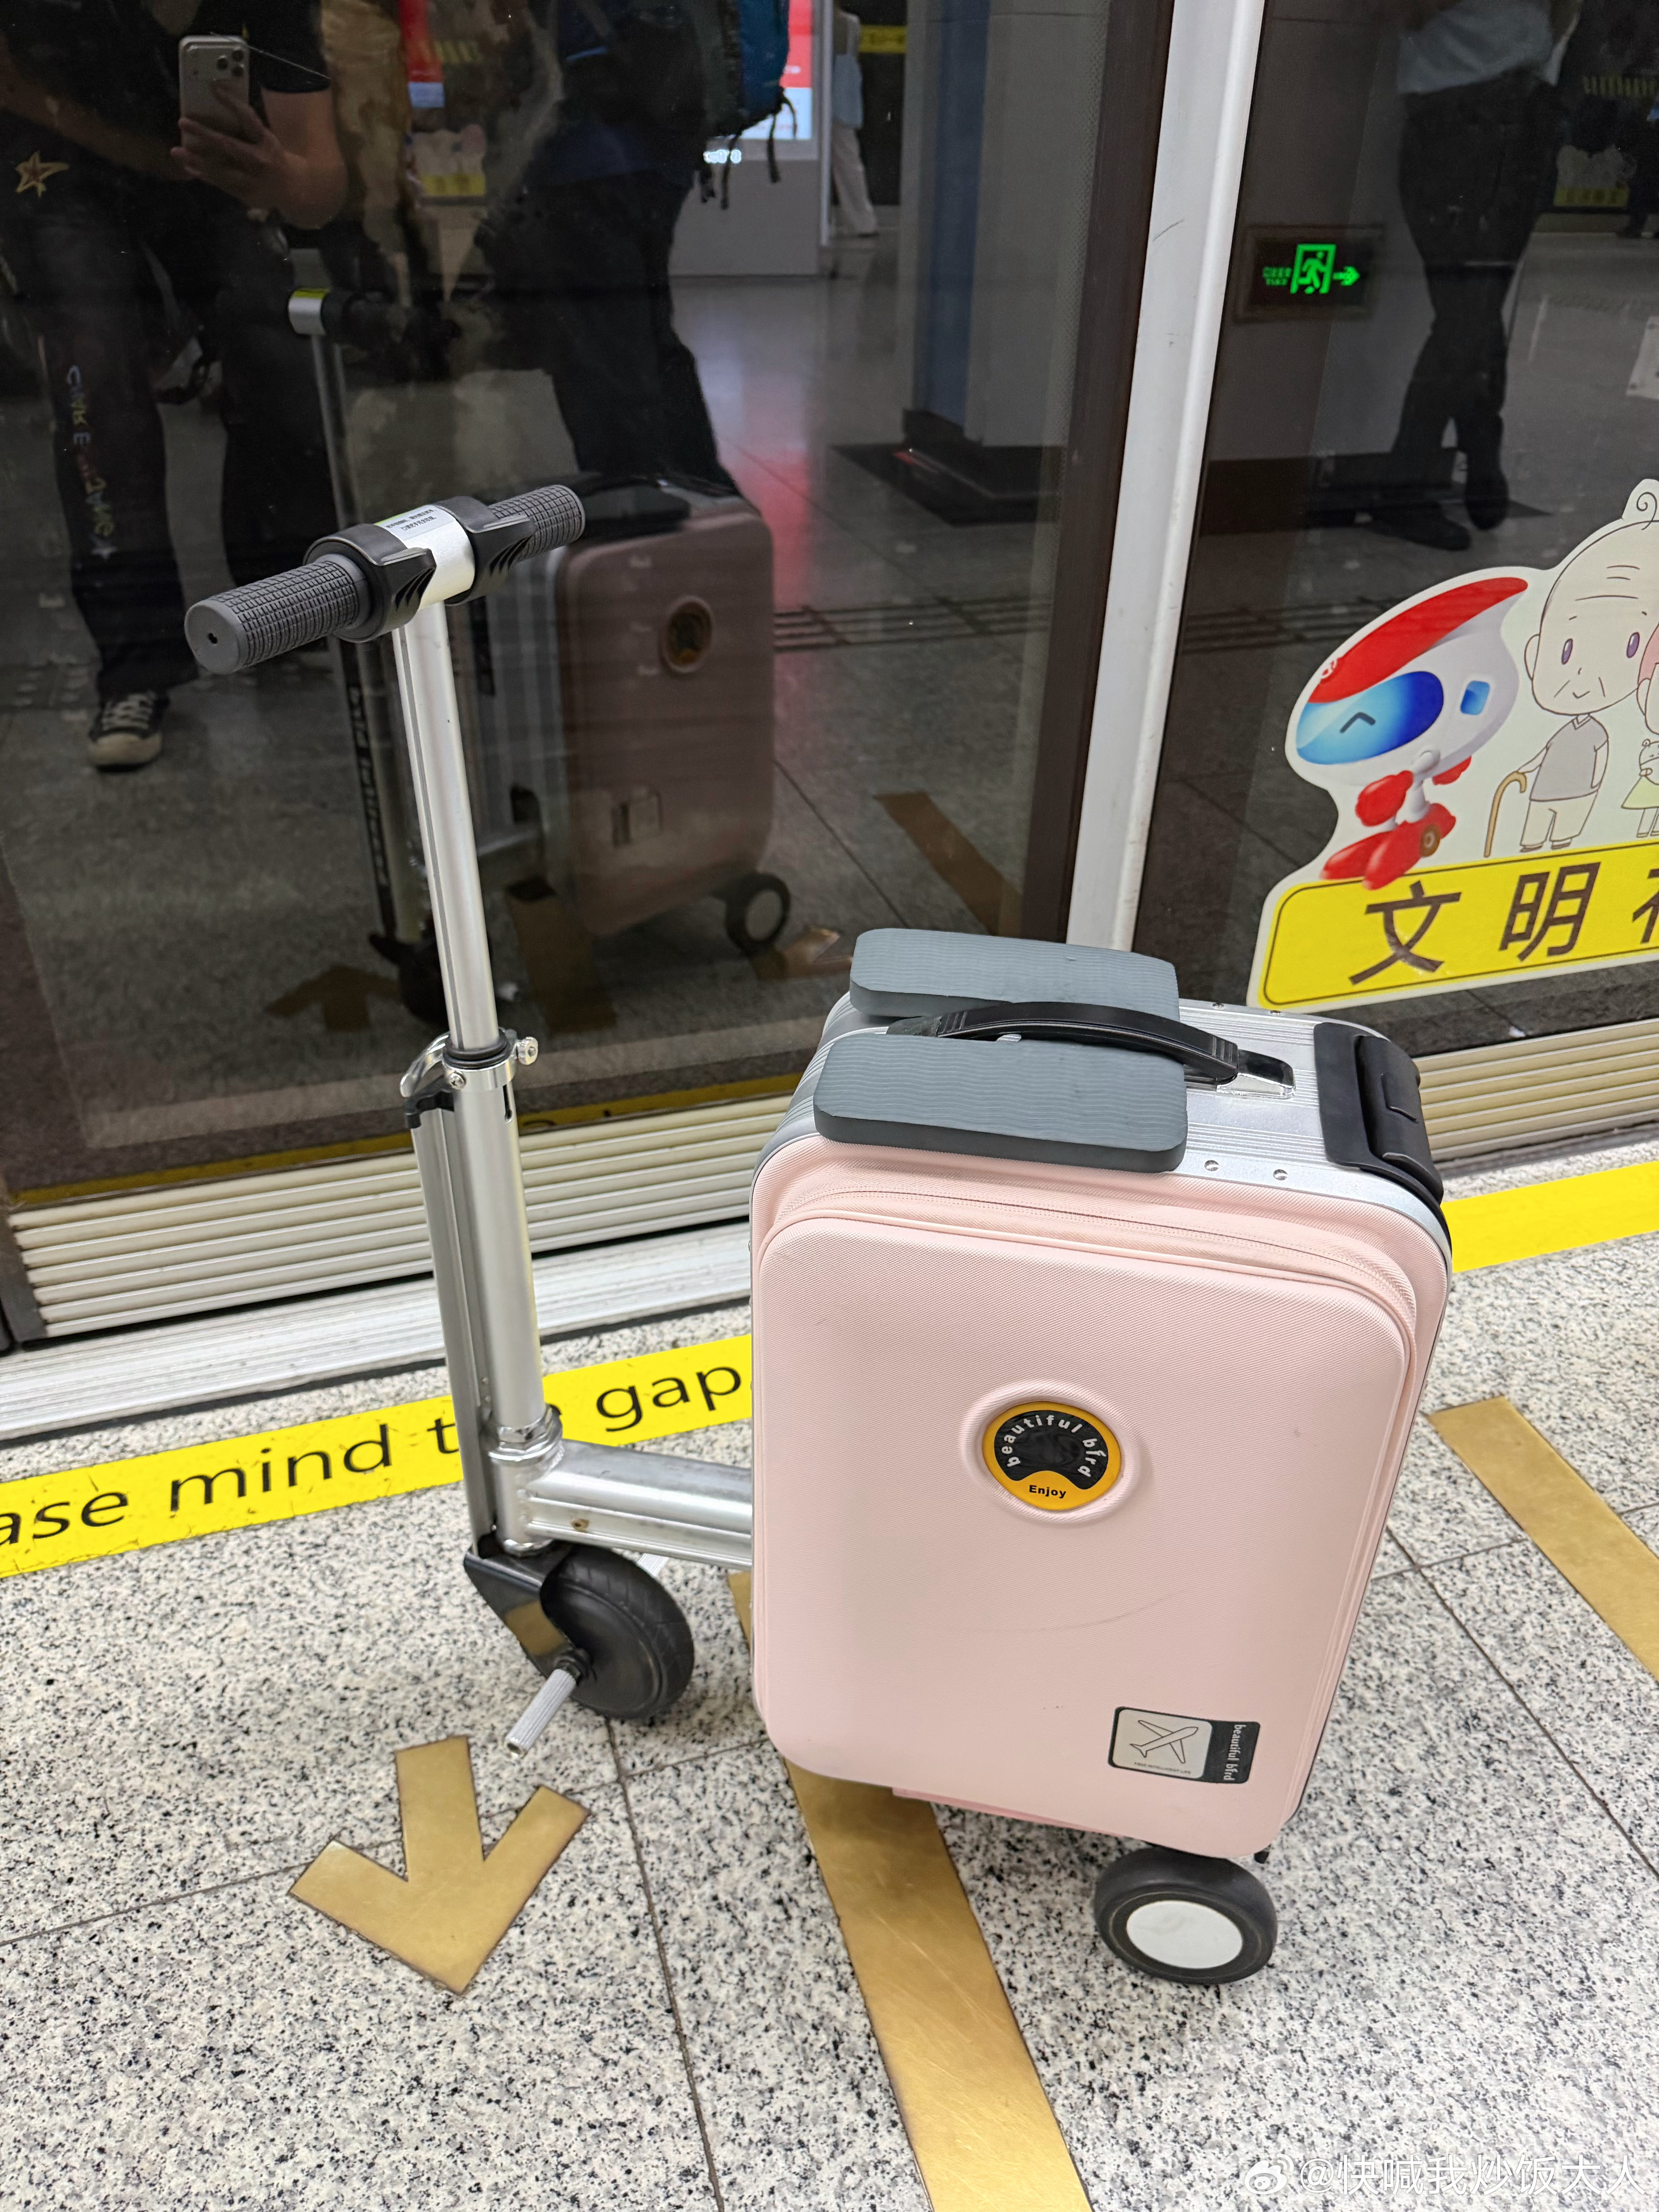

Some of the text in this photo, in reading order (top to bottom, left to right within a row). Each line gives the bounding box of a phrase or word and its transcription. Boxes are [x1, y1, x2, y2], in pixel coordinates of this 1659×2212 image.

[0, 1491, 129, 1545] ase
[170, 1423, 392, 1511] mind
[596, 1366, 742, 1432] gap
[1001, 1415, 1106, 1477] beautiful bfrd
[1029, 1485, 1066, 1499] Enjoy
[1223, 1724, 1247, 1781] beautiful bfrd
